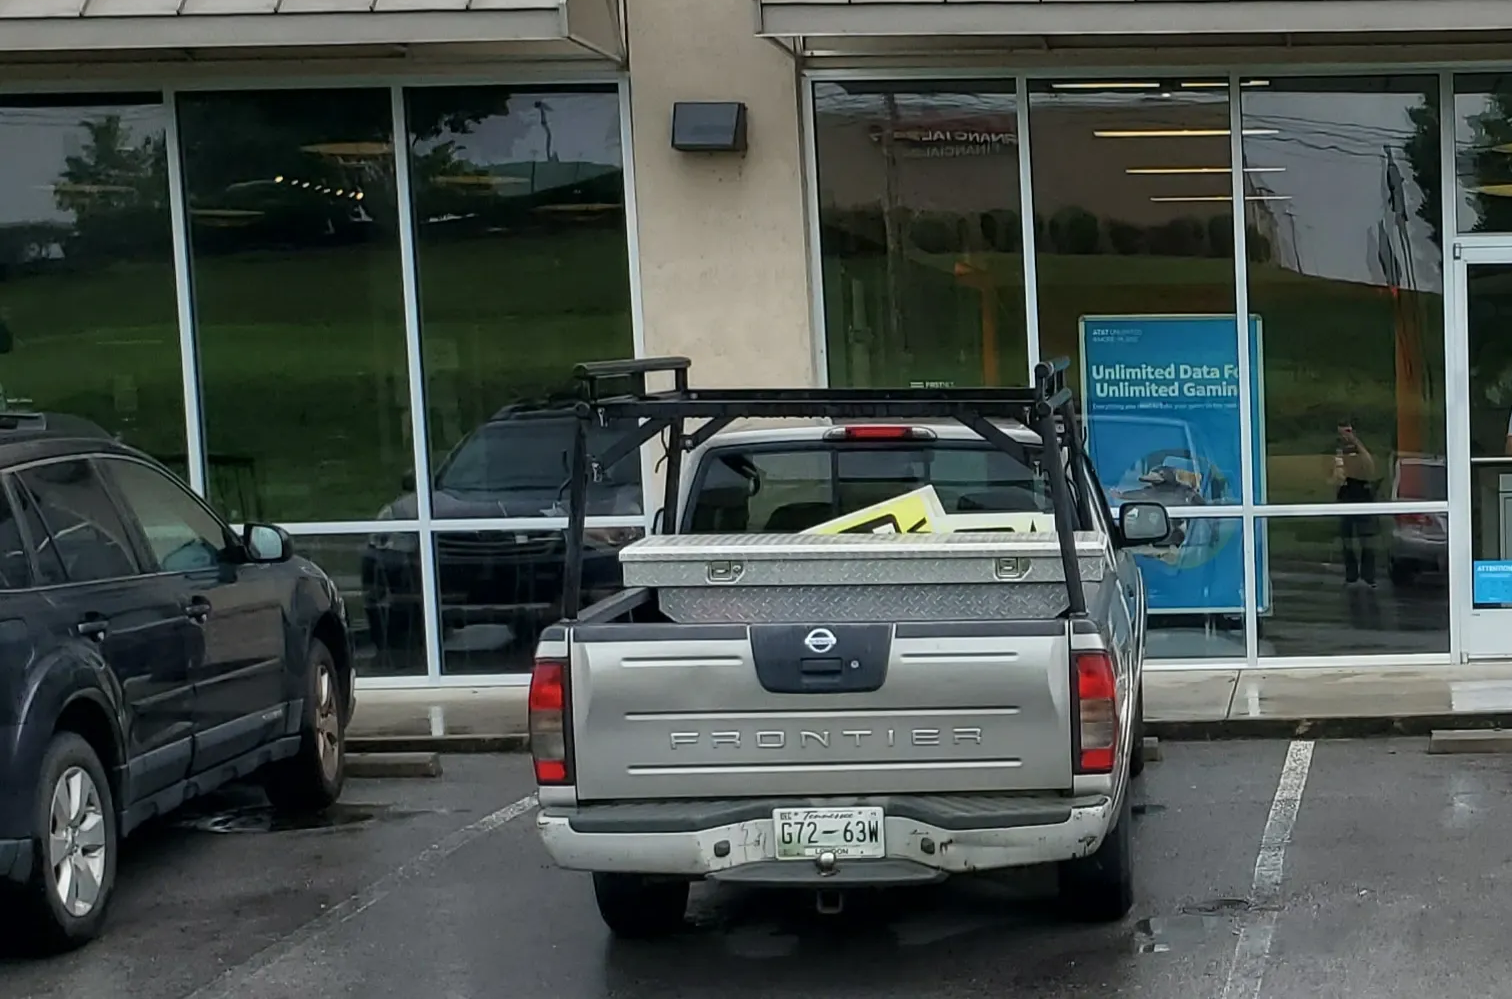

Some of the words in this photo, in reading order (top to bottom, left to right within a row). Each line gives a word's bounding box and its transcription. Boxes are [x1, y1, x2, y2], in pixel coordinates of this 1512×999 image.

[1092, 363, 1176, 380] Unlimited
[1179, 364, 1220, 379] Data
[1095, 382, 1179, 398] Unlimited
[1183, 381, 1239, 397] Gamin
[670, 727, 983, 750] FRONTIER
